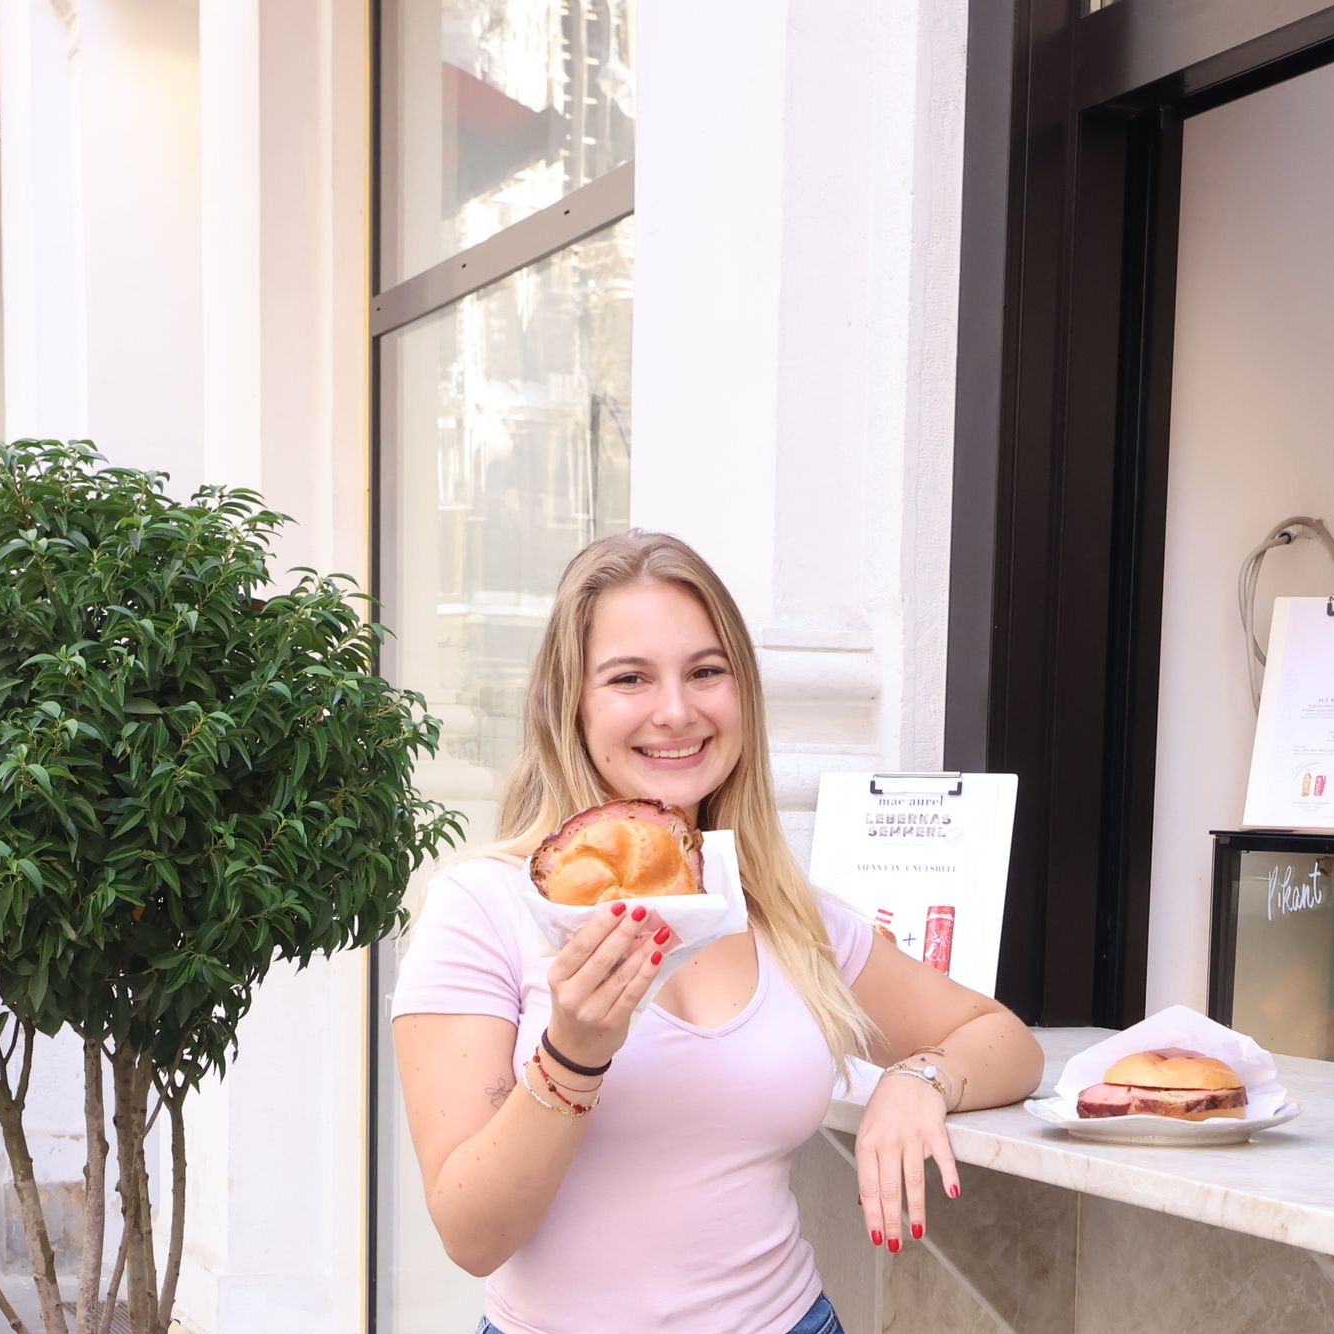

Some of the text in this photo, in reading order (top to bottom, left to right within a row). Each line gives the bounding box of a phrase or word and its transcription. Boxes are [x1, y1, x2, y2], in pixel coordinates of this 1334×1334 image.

[879, 795, 943, 806] mae aurel
[866, 813, 952, 825] LEBERKAS
[868, 826, 946, 838] SEMMERL
[1268, 862, 1322, 920] Pikant
